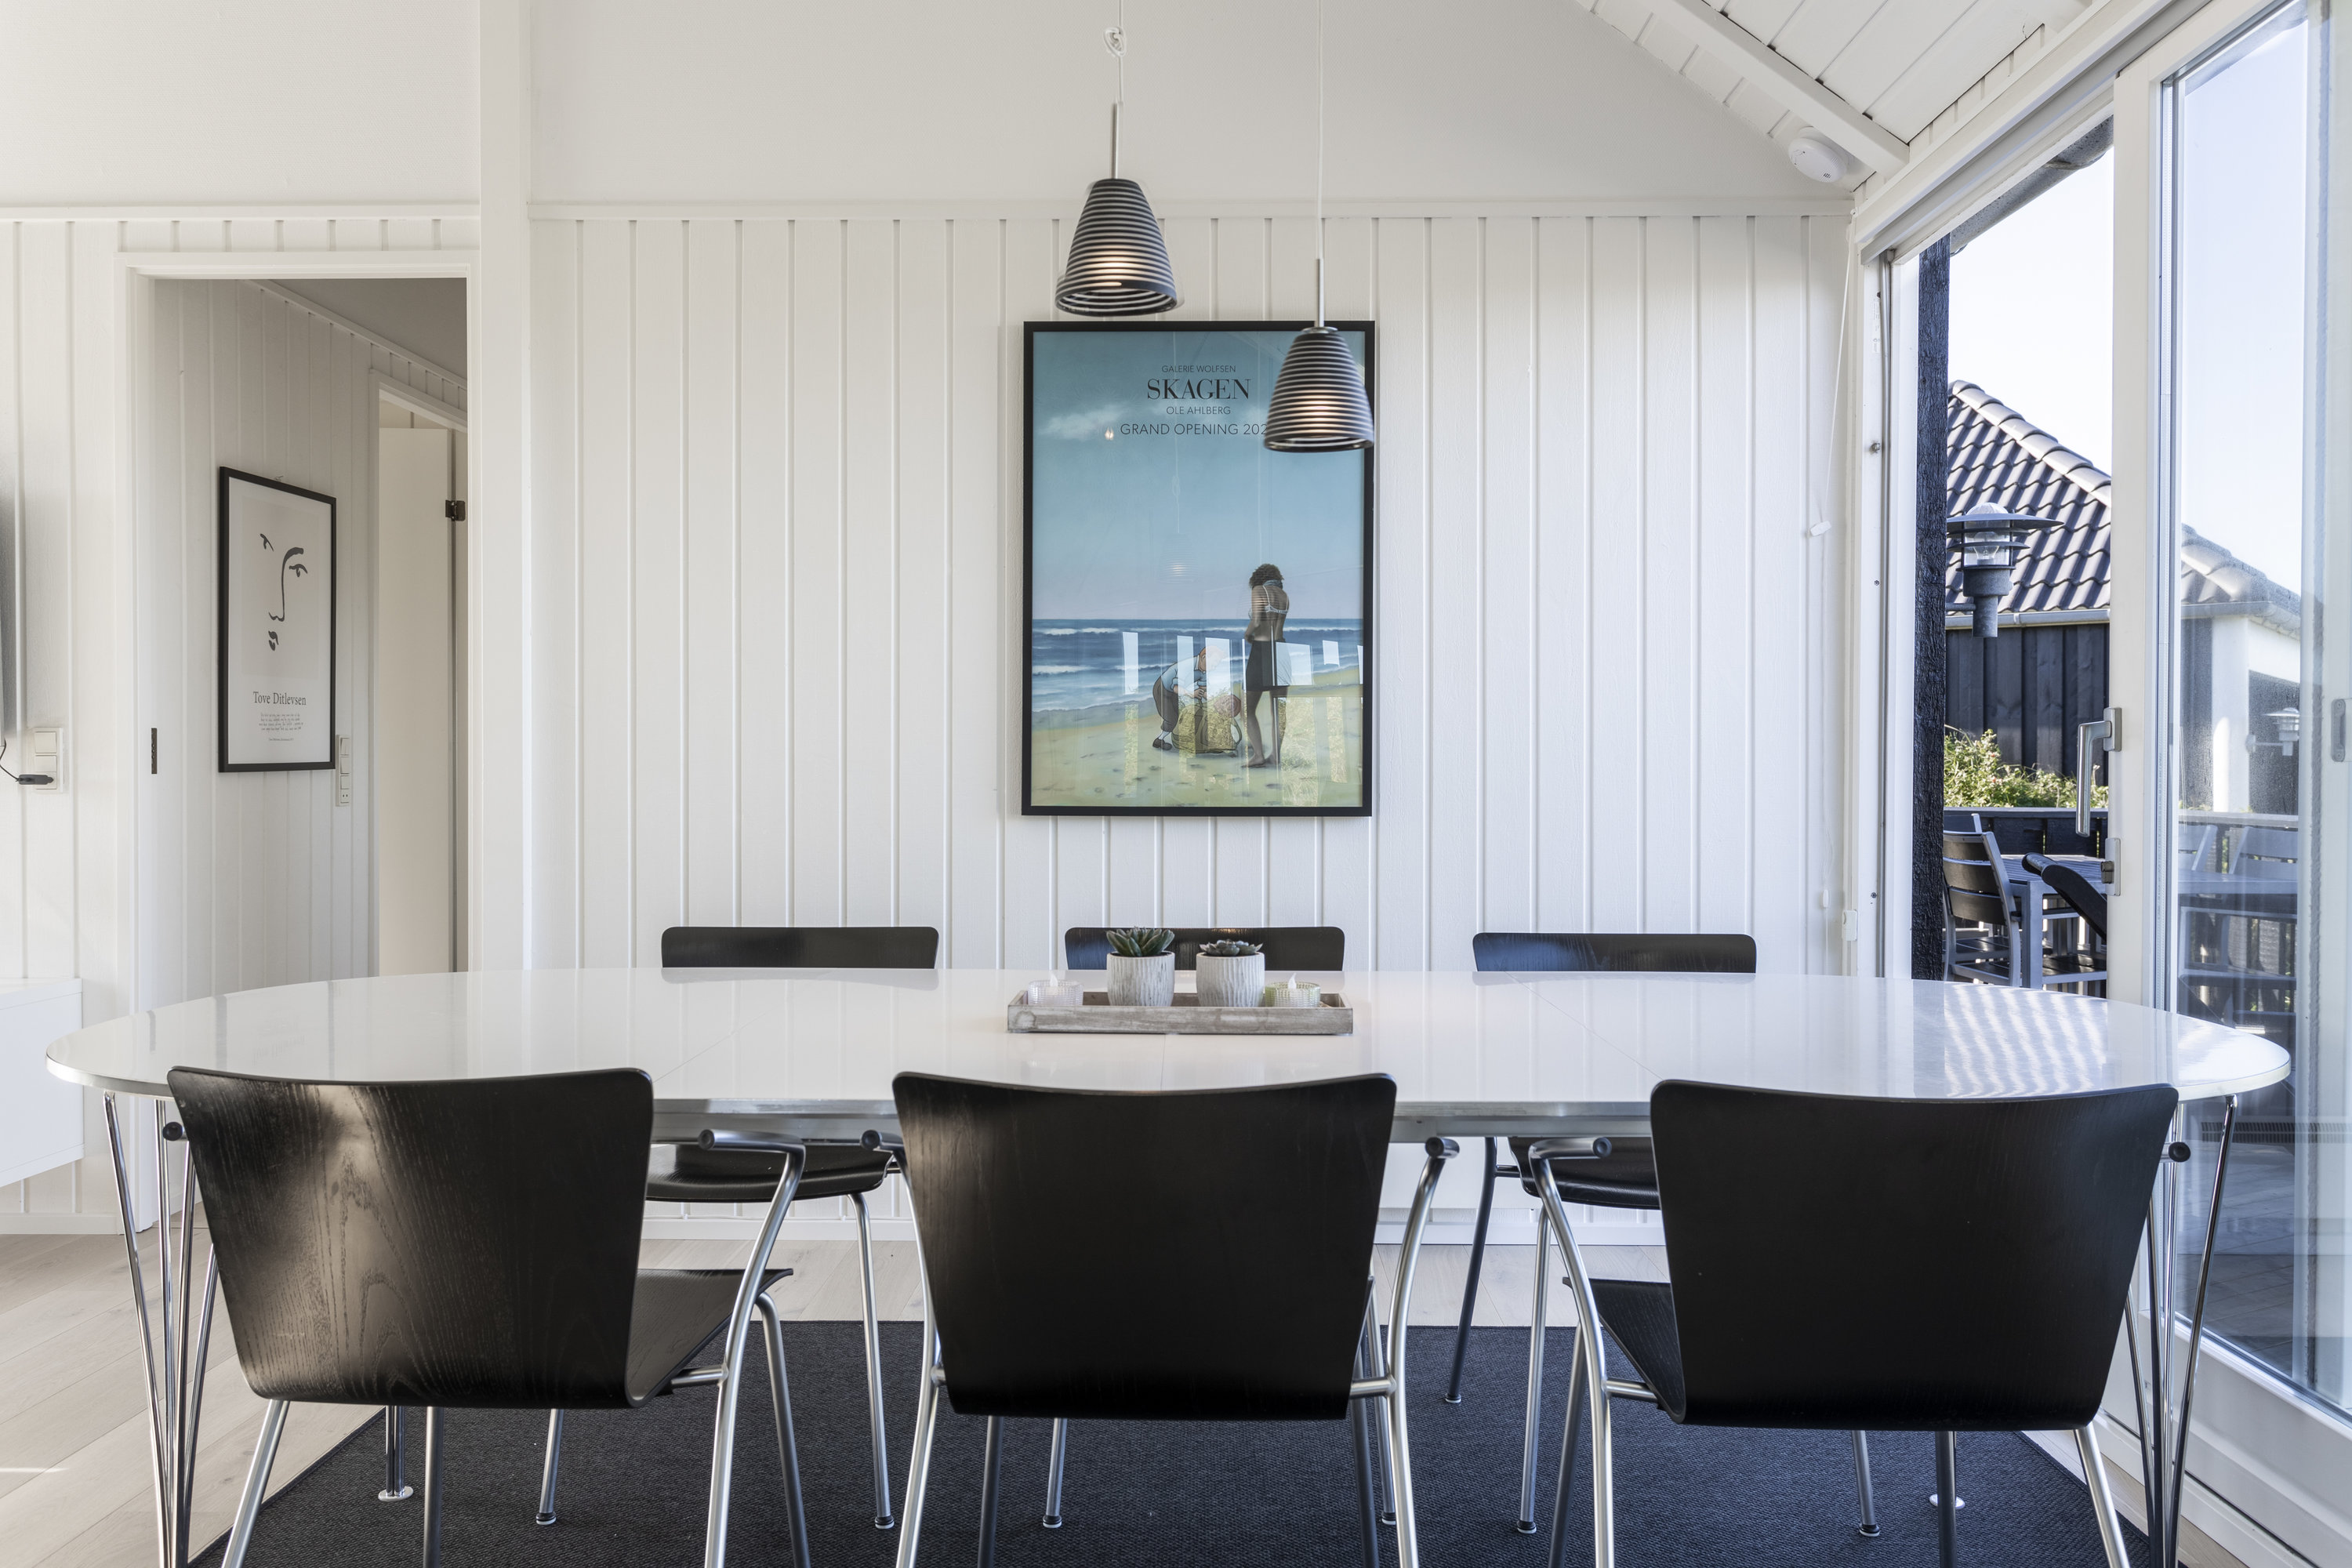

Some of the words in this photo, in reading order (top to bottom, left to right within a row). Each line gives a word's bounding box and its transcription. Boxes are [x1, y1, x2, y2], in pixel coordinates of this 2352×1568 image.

[1147, 379, 1251, 400] SKAGEN
[1120, 424, 1170, 435] GRAND
[1174, 424, 1239, 435] OPENING
[1243, 424, 1267, 435] 202
[253, 691, 270, 703] Tove
[273, 692, 307, 705] Ditlevsen
